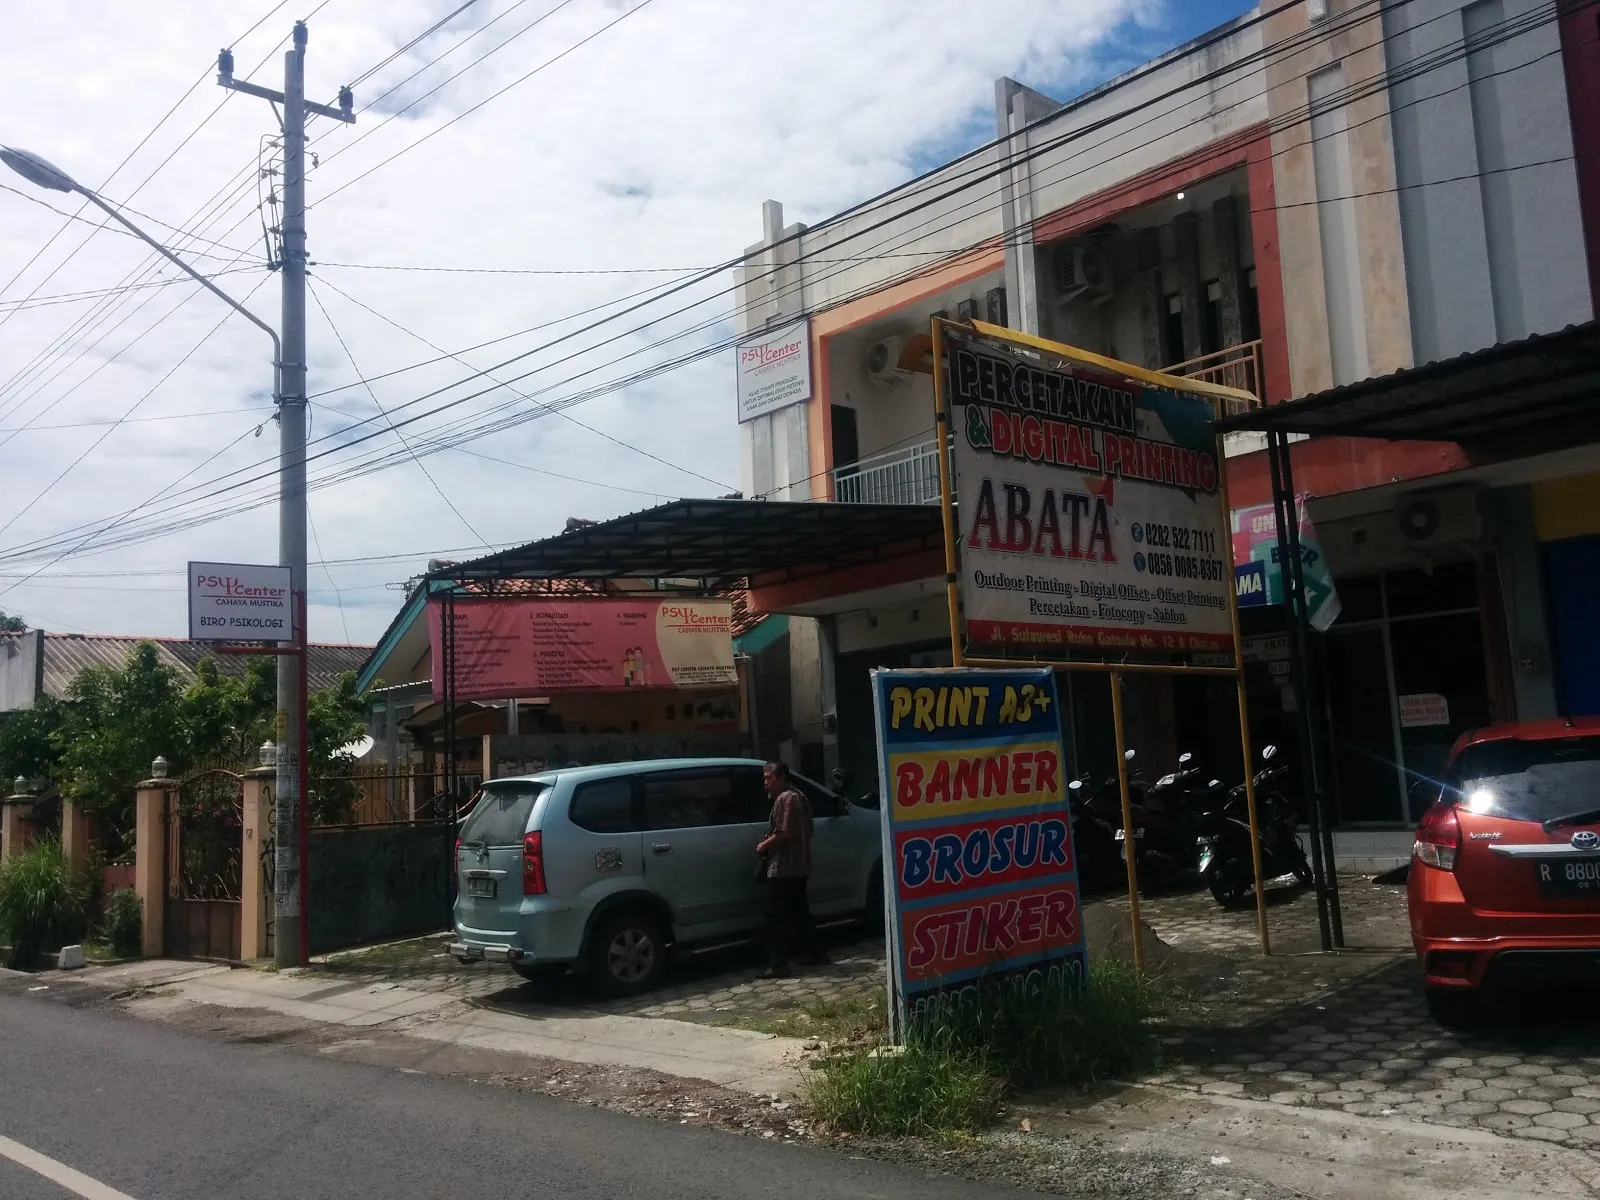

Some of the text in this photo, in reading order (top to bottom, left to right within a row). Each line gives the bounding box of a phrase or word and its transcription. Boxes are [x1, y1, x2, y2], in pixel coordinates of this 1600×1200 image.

[754, 353, 802, 376] CAHAYA MUSTIKA
[743, 397, 757, 407] UNTUK
[786, 379, 805, 390] POTENSI
[760, 383, 774, 394] TERAPI
[775, 375, 799, 388] PSIKOLOGI
[956, 349, 1135, 432] PERCETAKAN
[746, 388, 802, 411] ANAK DAN ORANG DEWASA
[966, 403, 1219, 493] & DIGITAL PRINTING
[967, 476, 1118, 564] ABATA
[1145, 522, 1215, 553] 0282 522 7111
[1147, 552, 1223, 582] 0856 0085 8367
[216, 598, 284, 608] CAHAYA MUSTIKA
[974, 570, 1026, 591] Outdoor
[1025, 574, 1073, 599] Printing
[1080, 580, 1118, 601] Digital
[1118, 583, 1151, 601] Offset
[1156, 586, 1187, 605] Offset
[1187, 589, 1226, 611] Printing
[200, 616, 284, 628] BIRO PSIKOLOGI
[446, 613, 468, 621] TRAPI
[1029, 597, 1091, 619] Percetakan
[1098, 603, 1146, 626] Fotocopy
[1152, 607, 1188, 625] Sablon
[702, 626, 730, 634] MUSTIKA
[990, 625, 1005, 642] Jl.
[1011, 626, 1062, 644] Sulawesi
[1067, 630, 1093, 646] Ruko
[1140, 632, 1156, 649] No.
[539, 650, 565, 658] PSIKOTES
[890, 684, 1052, 732] PRINT A3+
[896, 750, 1059, 808] BANNER
[901, 818, 1068, 889] BROSUR
[1540, 863, 1552, 881] R
[907, 889, 1076, 969] STIKER
